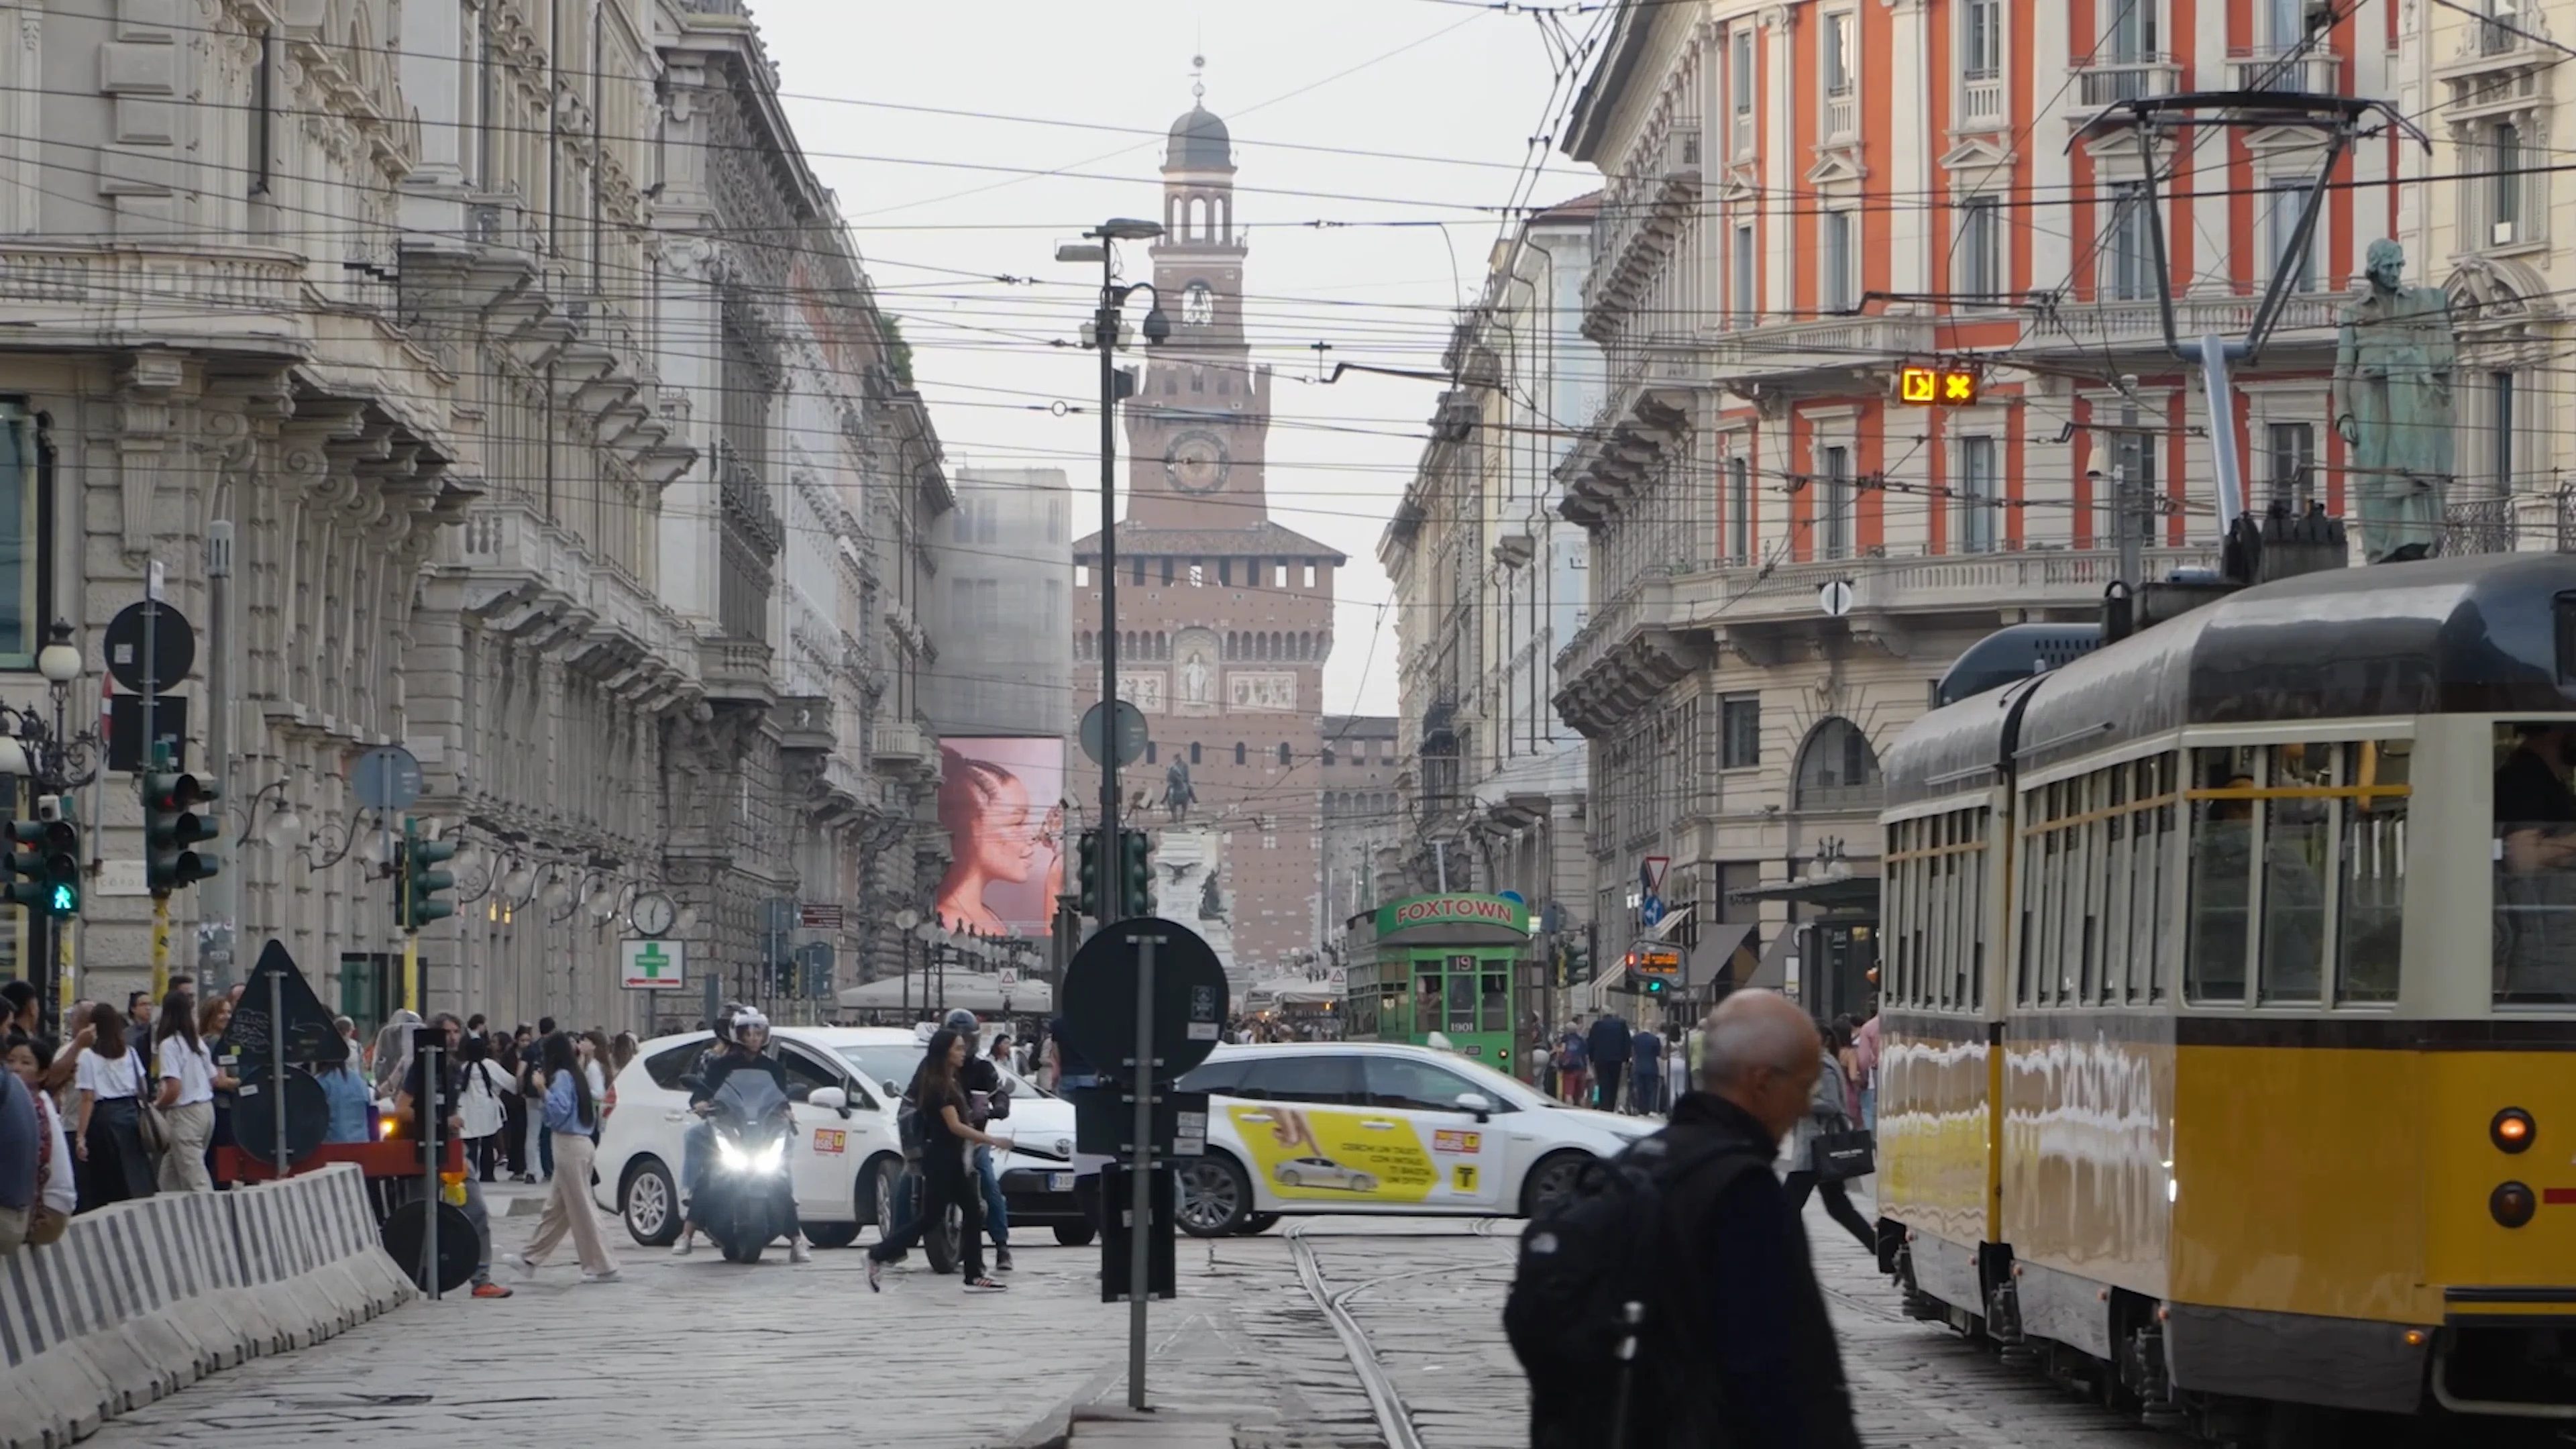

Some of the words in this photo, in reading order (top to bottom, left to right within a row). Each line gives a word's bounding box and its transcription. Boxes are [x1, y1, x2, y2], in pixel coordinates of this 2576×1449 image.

[1397, 899, 1513, 924] FOXTOWN
[1455, 956, 1471, 971] 19
[1457, 1167, 1474, 1187] T
